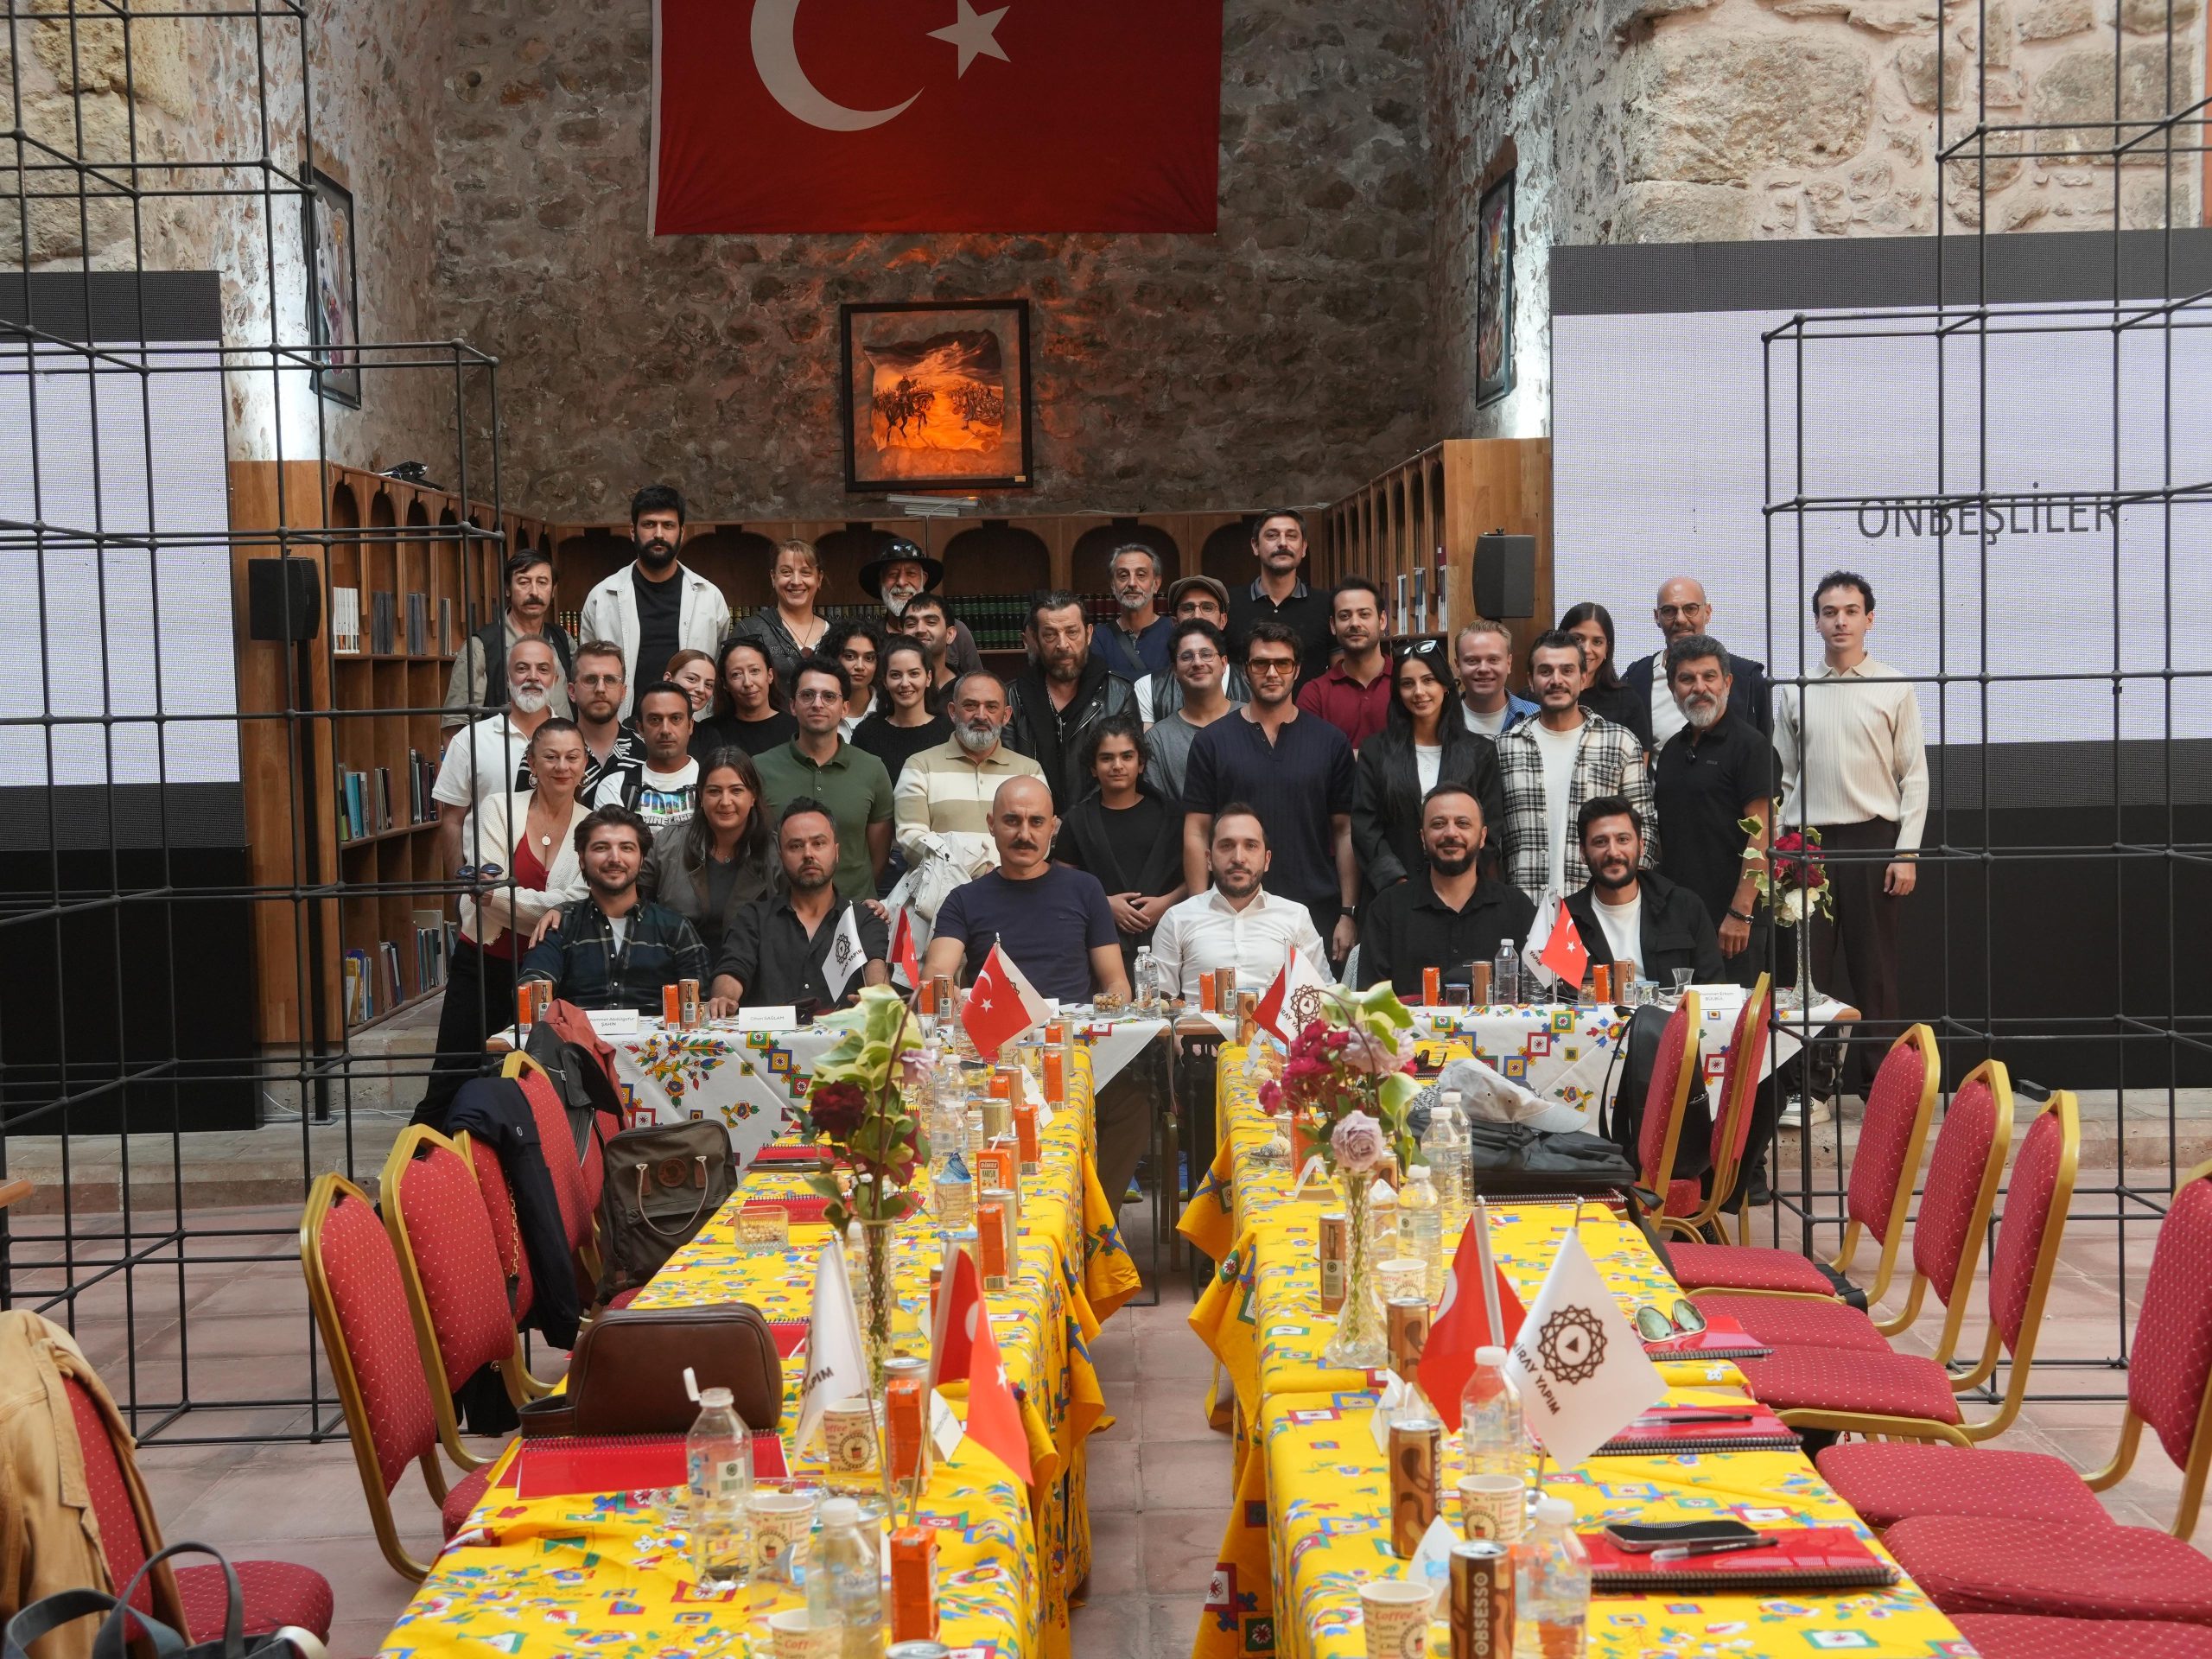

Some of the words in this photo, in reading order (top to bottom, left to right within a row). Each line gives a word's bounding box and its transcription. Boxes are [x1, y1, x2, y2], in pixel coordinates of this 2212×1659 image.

[1859, 481, 2116, 545] ONBEŞLİLER
[1535, 1375, 1560, 1415] YAPIM
[1473, 1572, 1489, 1656] OBSESSO
